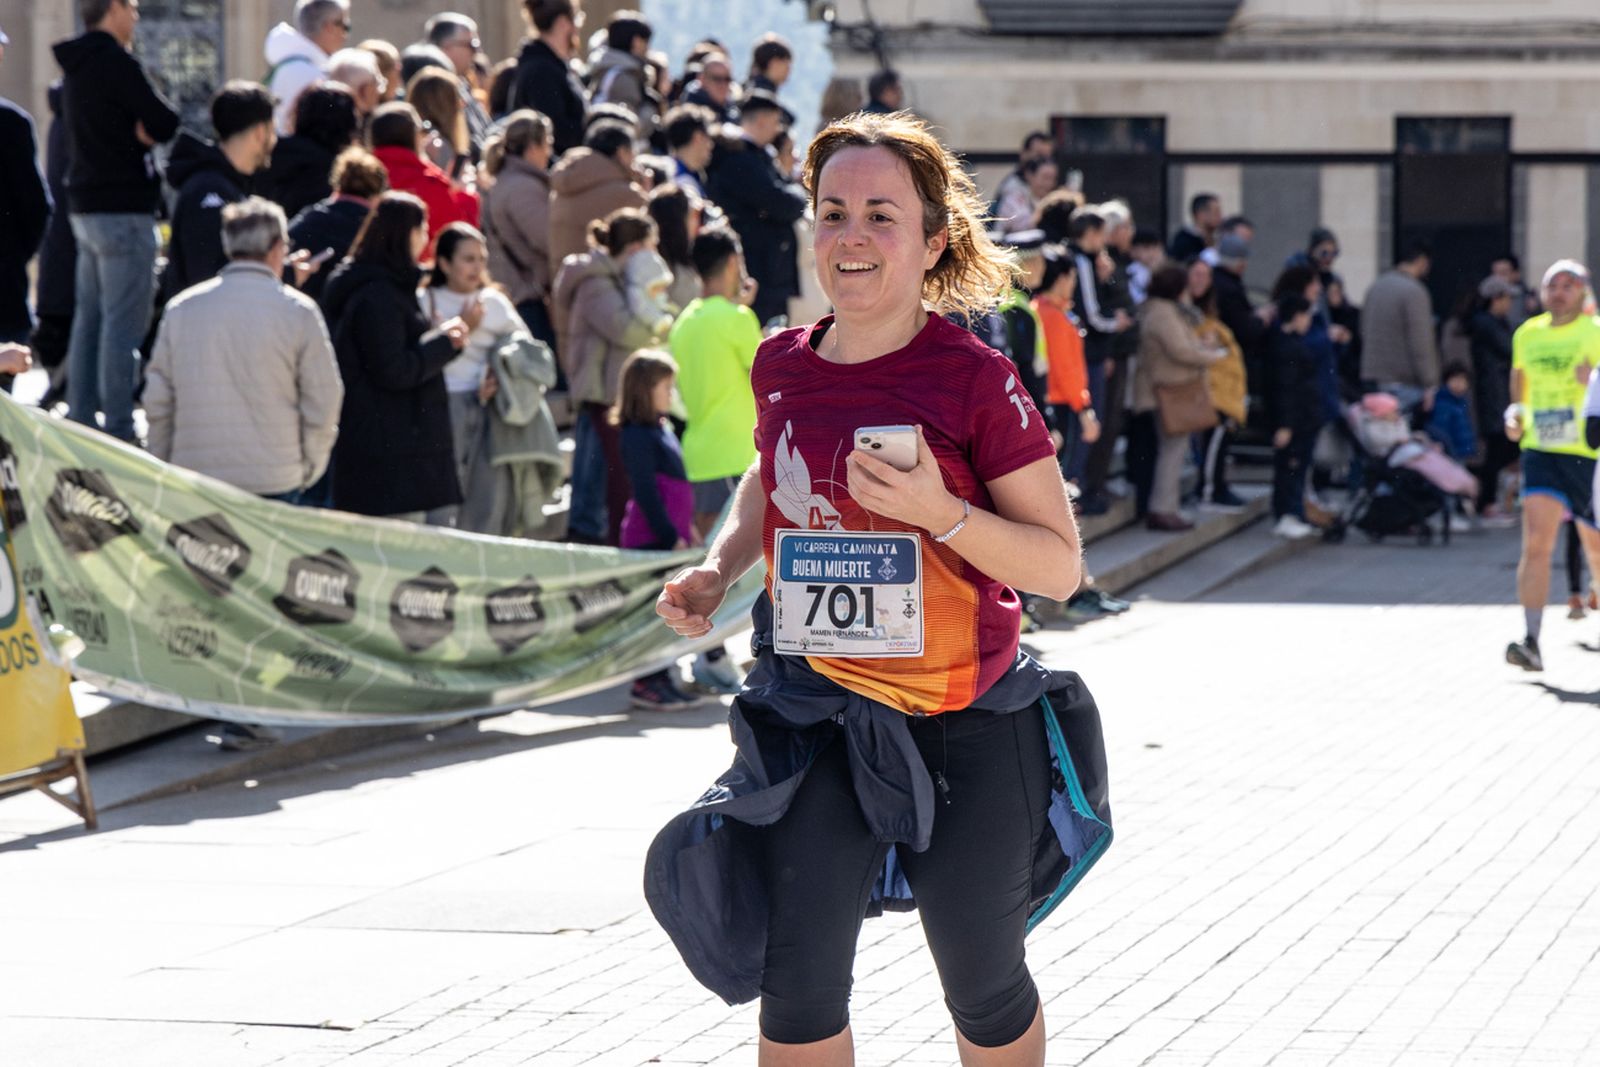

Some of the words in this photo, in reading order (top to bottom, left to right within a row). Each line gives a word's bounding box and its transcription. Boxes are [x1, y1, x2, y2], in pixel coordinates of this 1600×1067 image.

[794, 542, 802, 553] VI
[803, 542, 840, 554] CARRERA
[842, 543, 898, 555] CAMINATA
[792, 559, 822, 577] BUENA
[824, 560, 872, 578] MUERTE
[804, 584, 874, 629] 701
[810, 629, 831, 637] MAMEN
